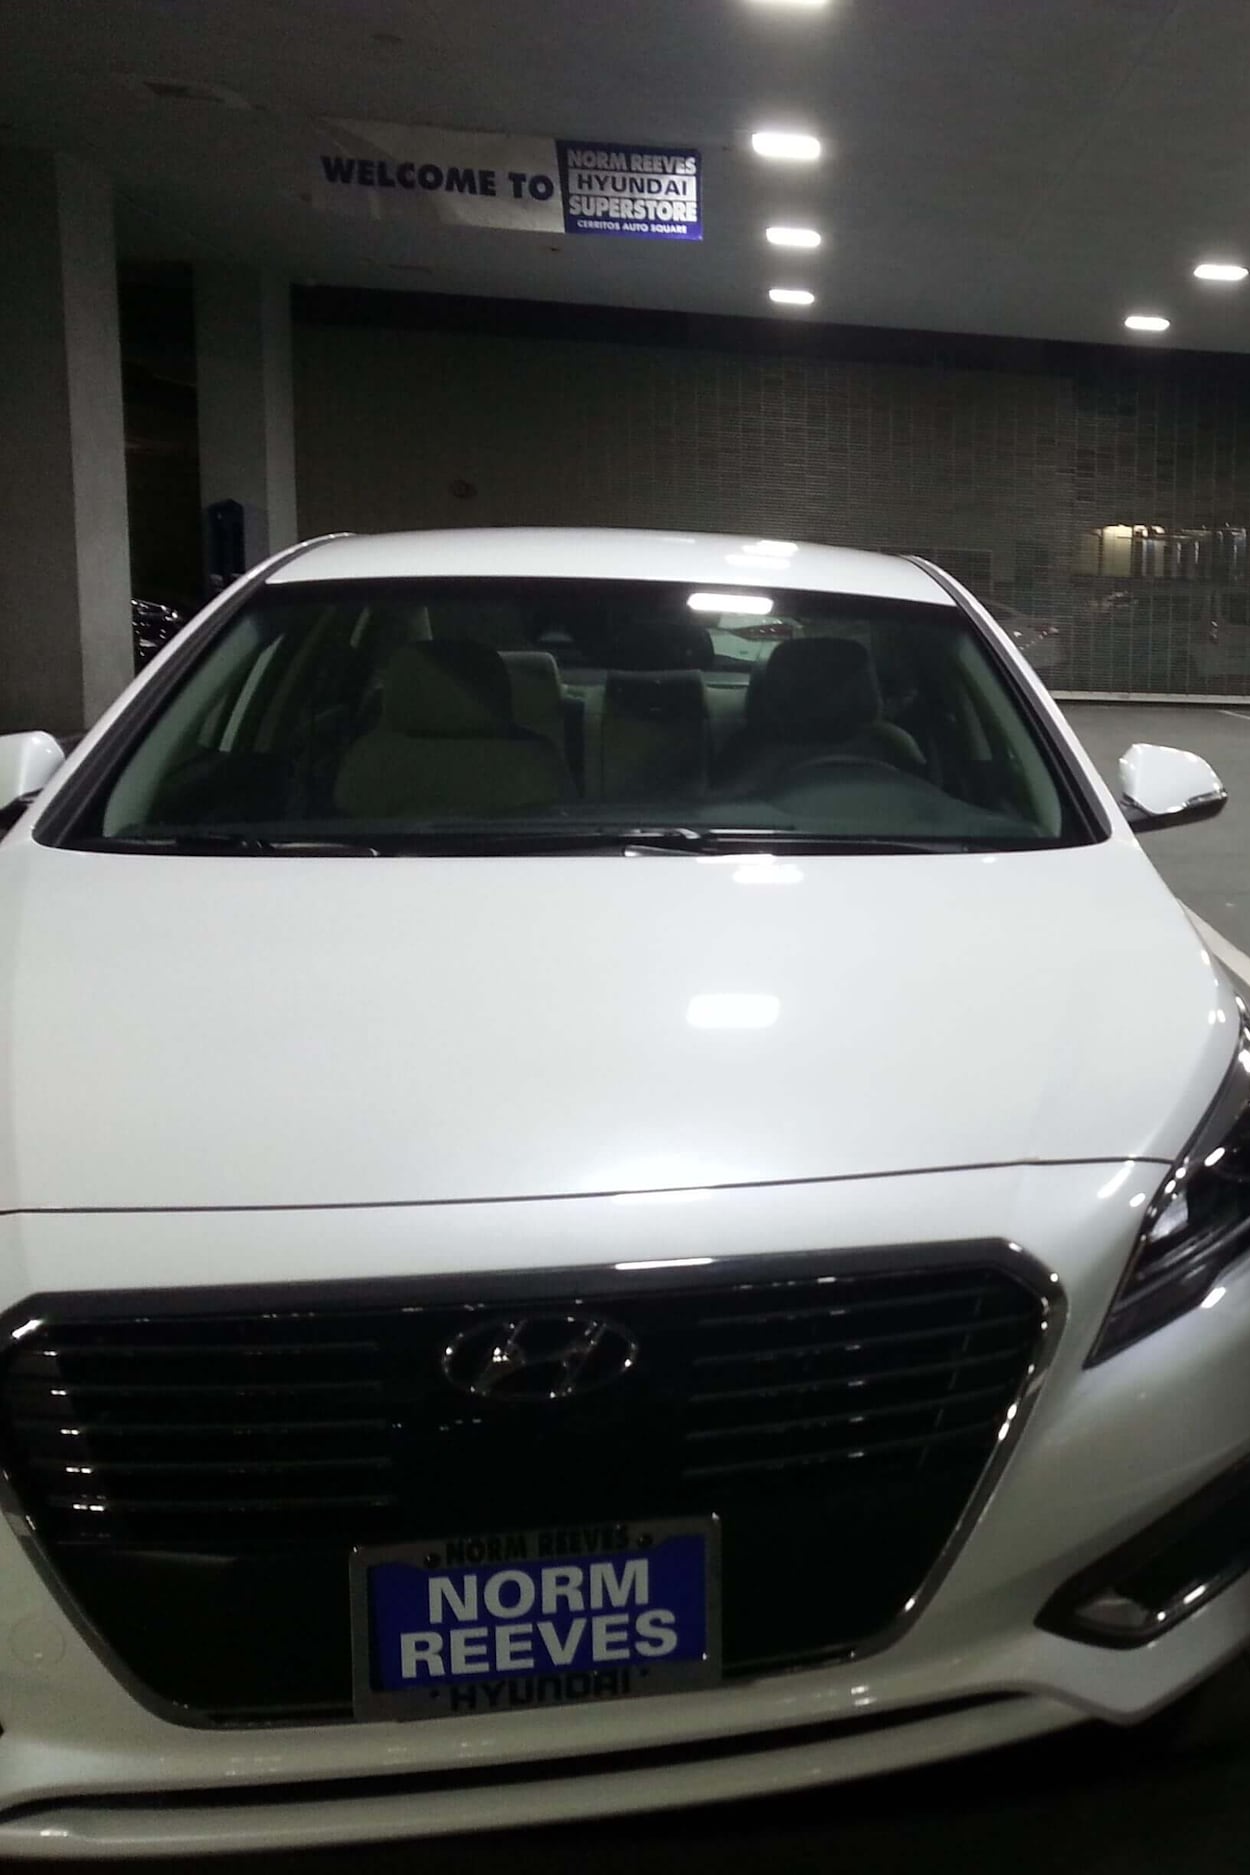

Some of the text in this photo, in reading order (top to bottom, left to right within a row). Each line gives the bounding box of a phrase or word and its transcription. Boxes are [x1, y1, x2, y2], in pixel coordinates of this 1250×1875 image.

[320, 155, 554, 200] WELCOME TO
[567, 149, 697, 175] NORM REEVES
[576, 173, 688, 196] HYUNDAI
[568, 195, 698, 222] SUPERSTORE
[576, 219, 688, 234] CERRITOS AUTO SQUARE
[446, 1523, 629, 1566] NORM REEVES
[428, 1557, 649, 1625] NORM
[400, 1608, 679, 1680] REEVES
[451, 1669, 631, 1711] HYUNDAI
